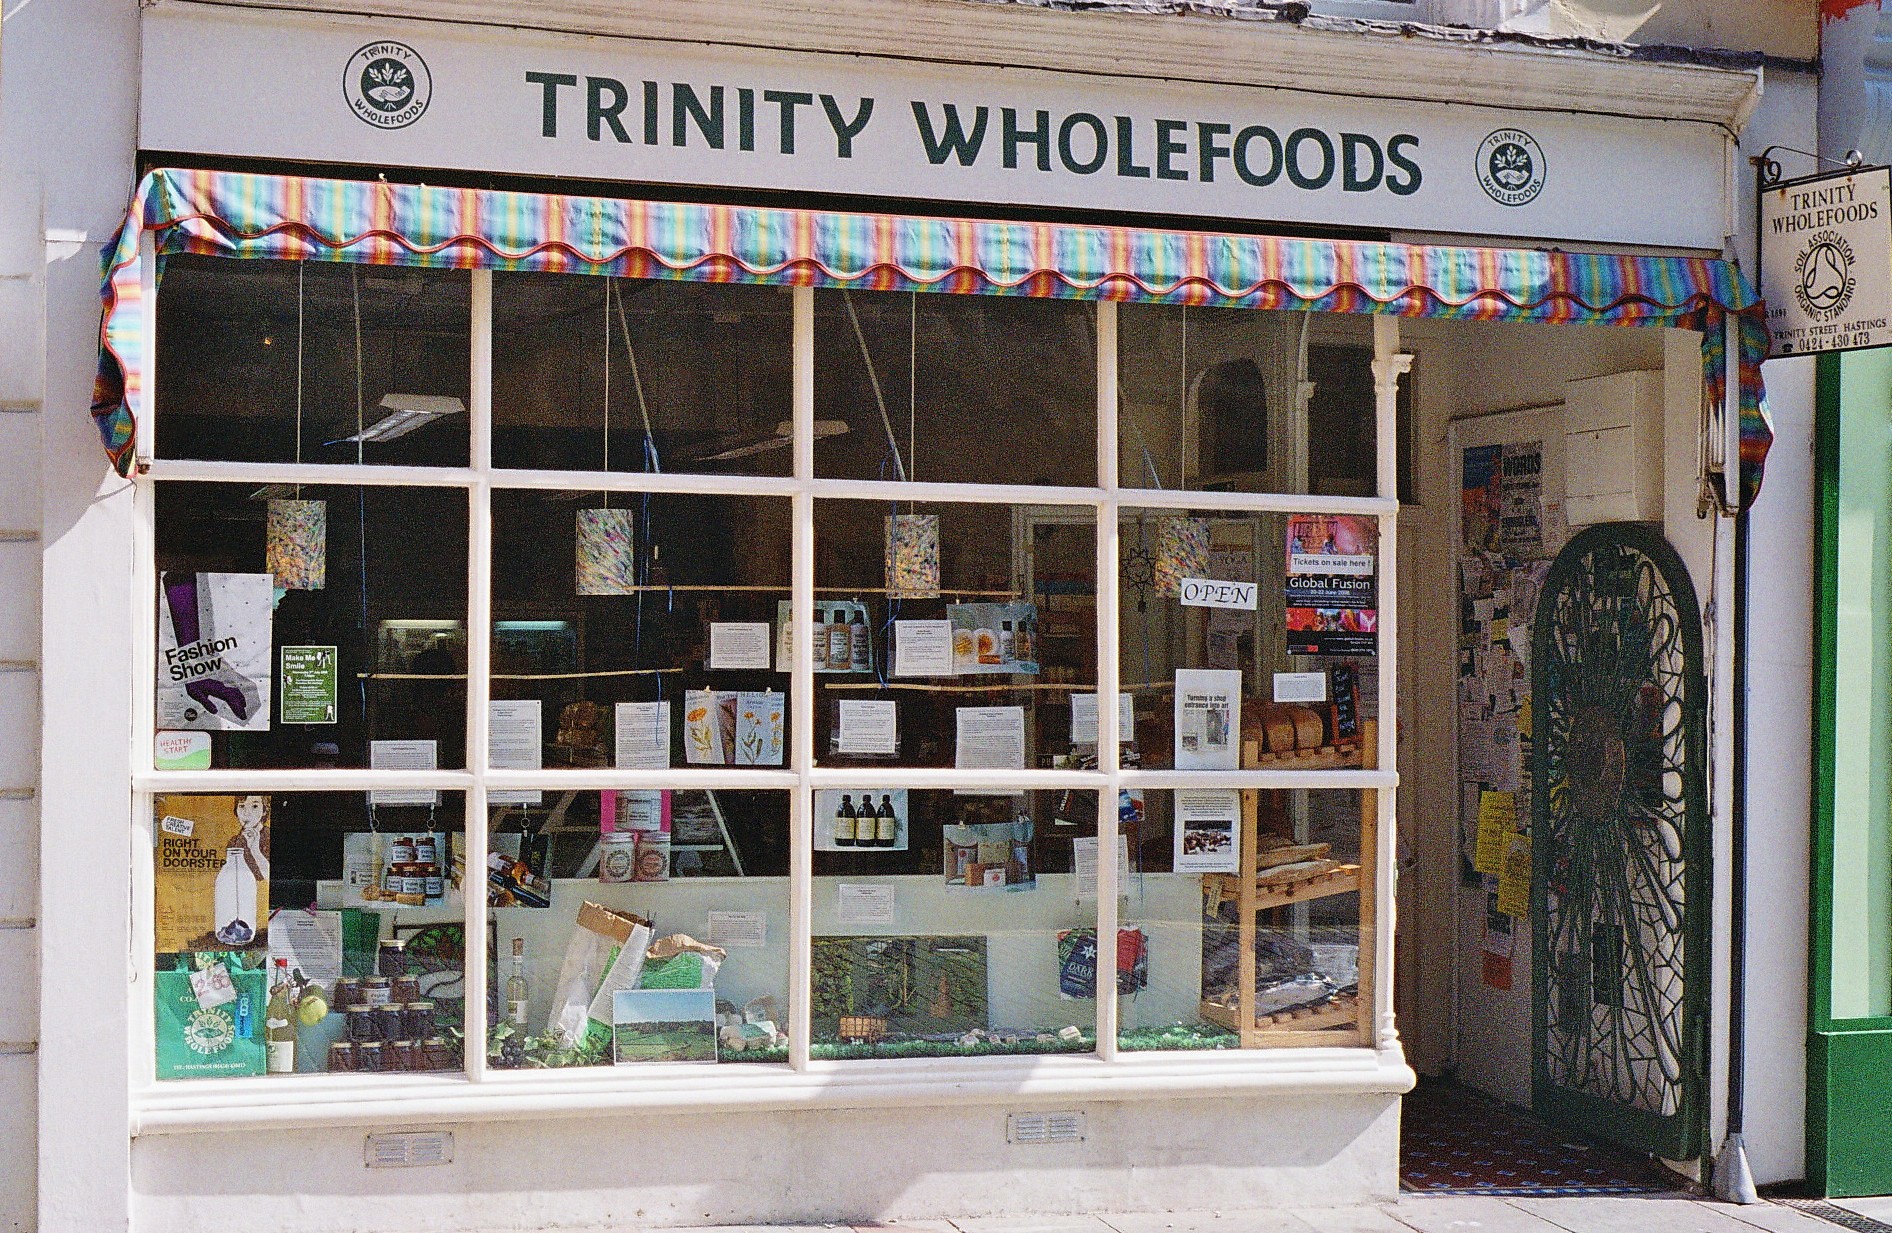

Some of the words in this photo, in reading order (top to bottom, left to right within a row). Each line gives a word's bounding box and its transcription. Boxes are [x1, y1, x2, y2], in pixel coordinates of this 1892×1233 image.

[361, 45, 412, 60] TRINITY
[355, 98, 424, 125] WHOLEFOODS
[526, 72, 874, 159] TRINITY
[910, 101, 1422, 195] WHOLEFOODS
[1488, 132, 1531, 147] TRINITY
[1483, 175, 1541, 202] WHOLEFOODS
[1790, 184, 1856, 211] TRINITY
[1772, 201, 1879, 234] WHOLEFOODS
[1794, 249, 1809, 273] SOIL
[1807, 230, 1856, 266] ASSOCIATION
[1794, 284, 1822, 323] ORGANIC
[1823, 277, 1857, 322] STANDARD
[1774, 328, 1806, 340] TRINITY
[1809, 324, 1838, 336] STREET
[1843, 318, 1887, 333] HASTINGS
[1852, 331, 1871, 346] 473
[1293, 557, 1319, 566] Tickets
[1332, 558, 1348, 567] sale
[1290, 577, 1328, 589] Global
[1332, 578, 1370, 590] Fusion
[1183, 583, 1254, 604] OPEN
[164, 635, 238, 666] Fashion
[285, 654, 304, 662] Make
[305, 654, 316, 662] Me
[169, 656, 222, 682] Show
[285, 662, 305, 670] Smile
[1187, 694, 1207, 702] Turning
[163, 838, 200, 848] RIGHT
[163, 849, 183, 858] ON
[184, 849, 217, 859] YOUR
[163, 858, 227, 868] DOORSTEP
